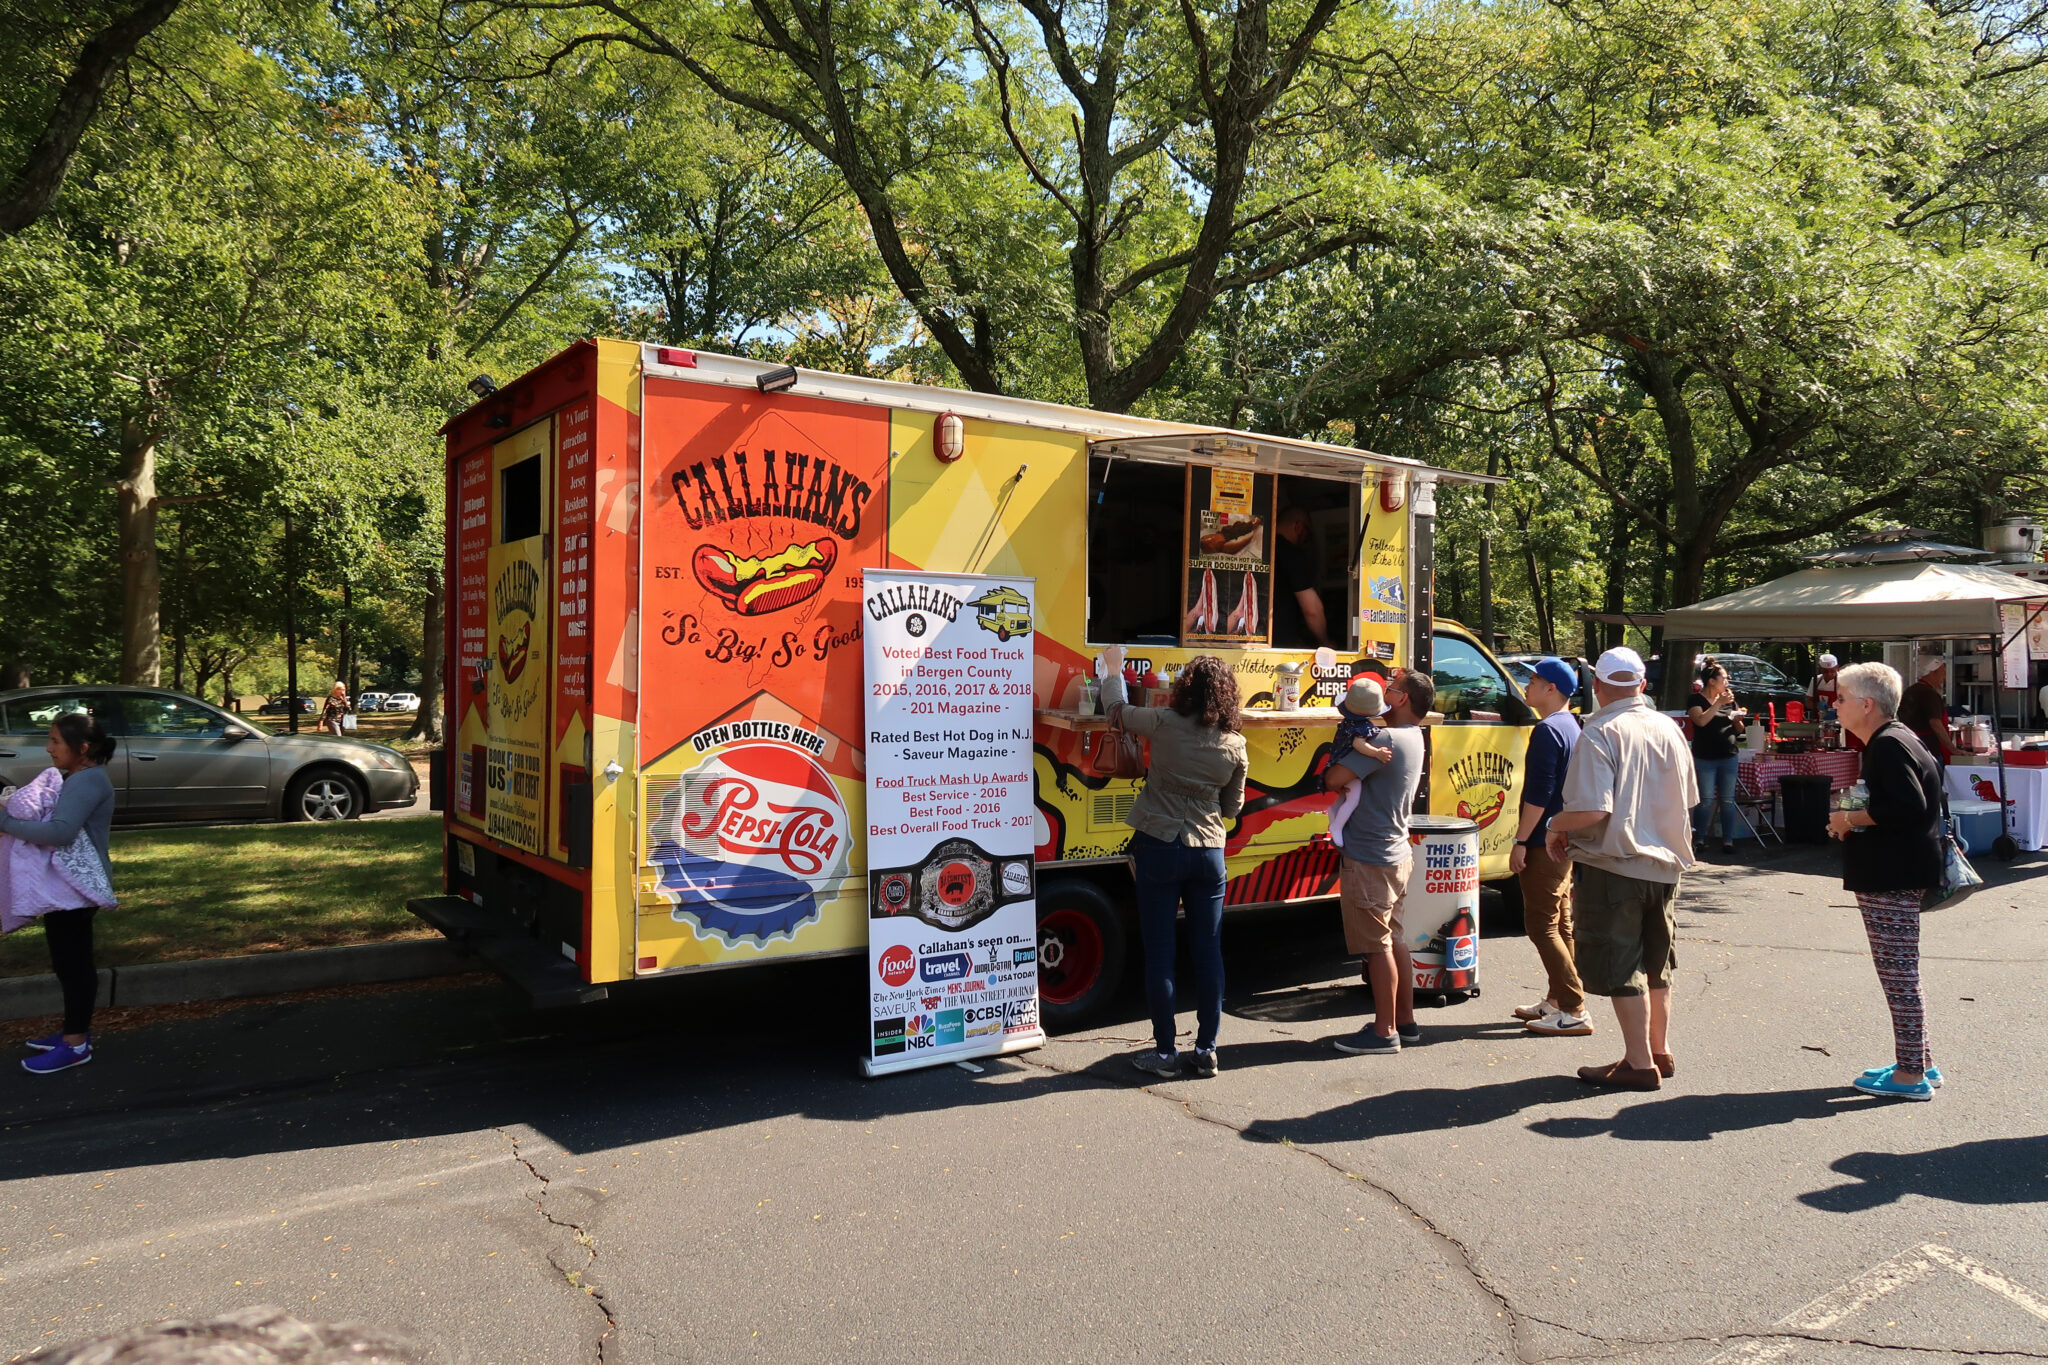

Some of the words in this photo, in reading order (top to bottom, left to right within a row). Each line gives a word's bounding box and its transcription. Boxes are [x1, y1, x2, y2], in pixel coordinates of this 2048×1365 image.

[672, 448, 871, 540] CALLAHAN'S
[1369, 537, 1395, 552] Follow
[1189, 559, 1212, 569] SUPER
[1371, 552, 1391, 566] Like
[655, 566, 684, 580] EST.
[846, 580, 863, 593] 195
[867, 584, 963, 623] CALLAHAN'S
[706, 628, 767, 664] Big!
[772, 632, 806, 668] So
[814, 617, 863, 661] Good
[883, 647, 920, 660] Voted
[924, 647, 952, 660] Best
[956, 648, 987, 660] Food
[991, 648, 1024, 660] Truck
[901, 666, 914, 677] in
[917, 665, 963, 681] Bergen
[967, 665, 1013, 680] County
[873, 684, 912, 697] 2015,
[916, 684, 952, 698] 2016,
[955, 684, 986, 696] 2017
[989, 684, 1000, 696] &
[1003, 684, 1032, 696] 2018
[1317, 682, 1347, 696] HERE
[911, 702, 934, 714] 201
[938, 702, 1001, 716] Magazine
[693, 726, 730, 750] OPEN
[733, 721, 790, 742] BOTTLES
[791, 729, 825, 755] HERE
[871, 731, 909, 743] Rated
[913, 731, 939, 742] Best
[943, 730, 965, 741] Hot
[969, 729, 993, 743] Dog
[998, 729, 1008, 740] in
[1012, 729, 1032, 740] N.J.
[903, 748, 944, 760] Saveur
[948, 747, 1008, 760] Magazine
[488, 765, 505, 791] US
[876, 777, 904, 788] Food
[907, 776, 936, 787] Truck
[940, 774, 970, 785] Mash
[974, 773, 989, 785] Up
[992, 772, 1029, 783] Awards
[1448, 752, 1514, 794] CALLAHAN'S
[903, 791, 926, 802] Best
[930, 790, 969, 801] Service
[980, 788, 1007, 799] 2016
[910, 807, 933, 818] Best
[936, 805, 962, 816] Food
[973, 803, 1001, 814] 2016
[870, 825, 897, 836] Best
[900, 822, 939, 834] Overall
[942, 820, 968, 832] Food
[971, 818, 1001, 829] Truck
[1011, 816, 1033, 827] 2017
[1426, 844, 1454, 855] THIS
[1458, 844, 1466, 854] IS
[1426, 857, 1450, 867] THE
[1453, 855, 1475, 867] PEPS
[1425, 869, 1452, 880] FOR
[1455, 867, 1477, 879] EVER
[919, 938, 976, 955] Callahan's
[978, 937, 1003, 948] seen
[1455, 948, 1473, 957] PEPS
[1014, 950, 1036, 962] Bravo
[881, 954, 915, 980] food
[925, 958, 961, 975] travel
[998, 973, 1012, 983] USA
[1013, 970, 1036, 981] TODAY
[873, 993, 888, 1003] The
[889, 991, 905, 1001] New
[906, 989, 924, 1000] York
[924, 986, 946, 996] Times
[947, 983, 962, 995] MEN'S
[963, 980, 986, 993] JOURNAL
[944, 996, 957, 1008] THE
[957, 994, 980, 1006] WALL
[980, 989, 1006, 1002] STREET
[1007, 985, 1036, 999] JOURNAL
[874, 1002, 918, 1018] SAVEUR
[976, 1006, 1002, 1020] CBS
[1013, 1000, 1036, 1013] FOX
[1007, 1012, 1037, 1027] NEWS
[877, 1029, 903, 1038] INSIDER
[907, 1035, 934, 1050] NBC
